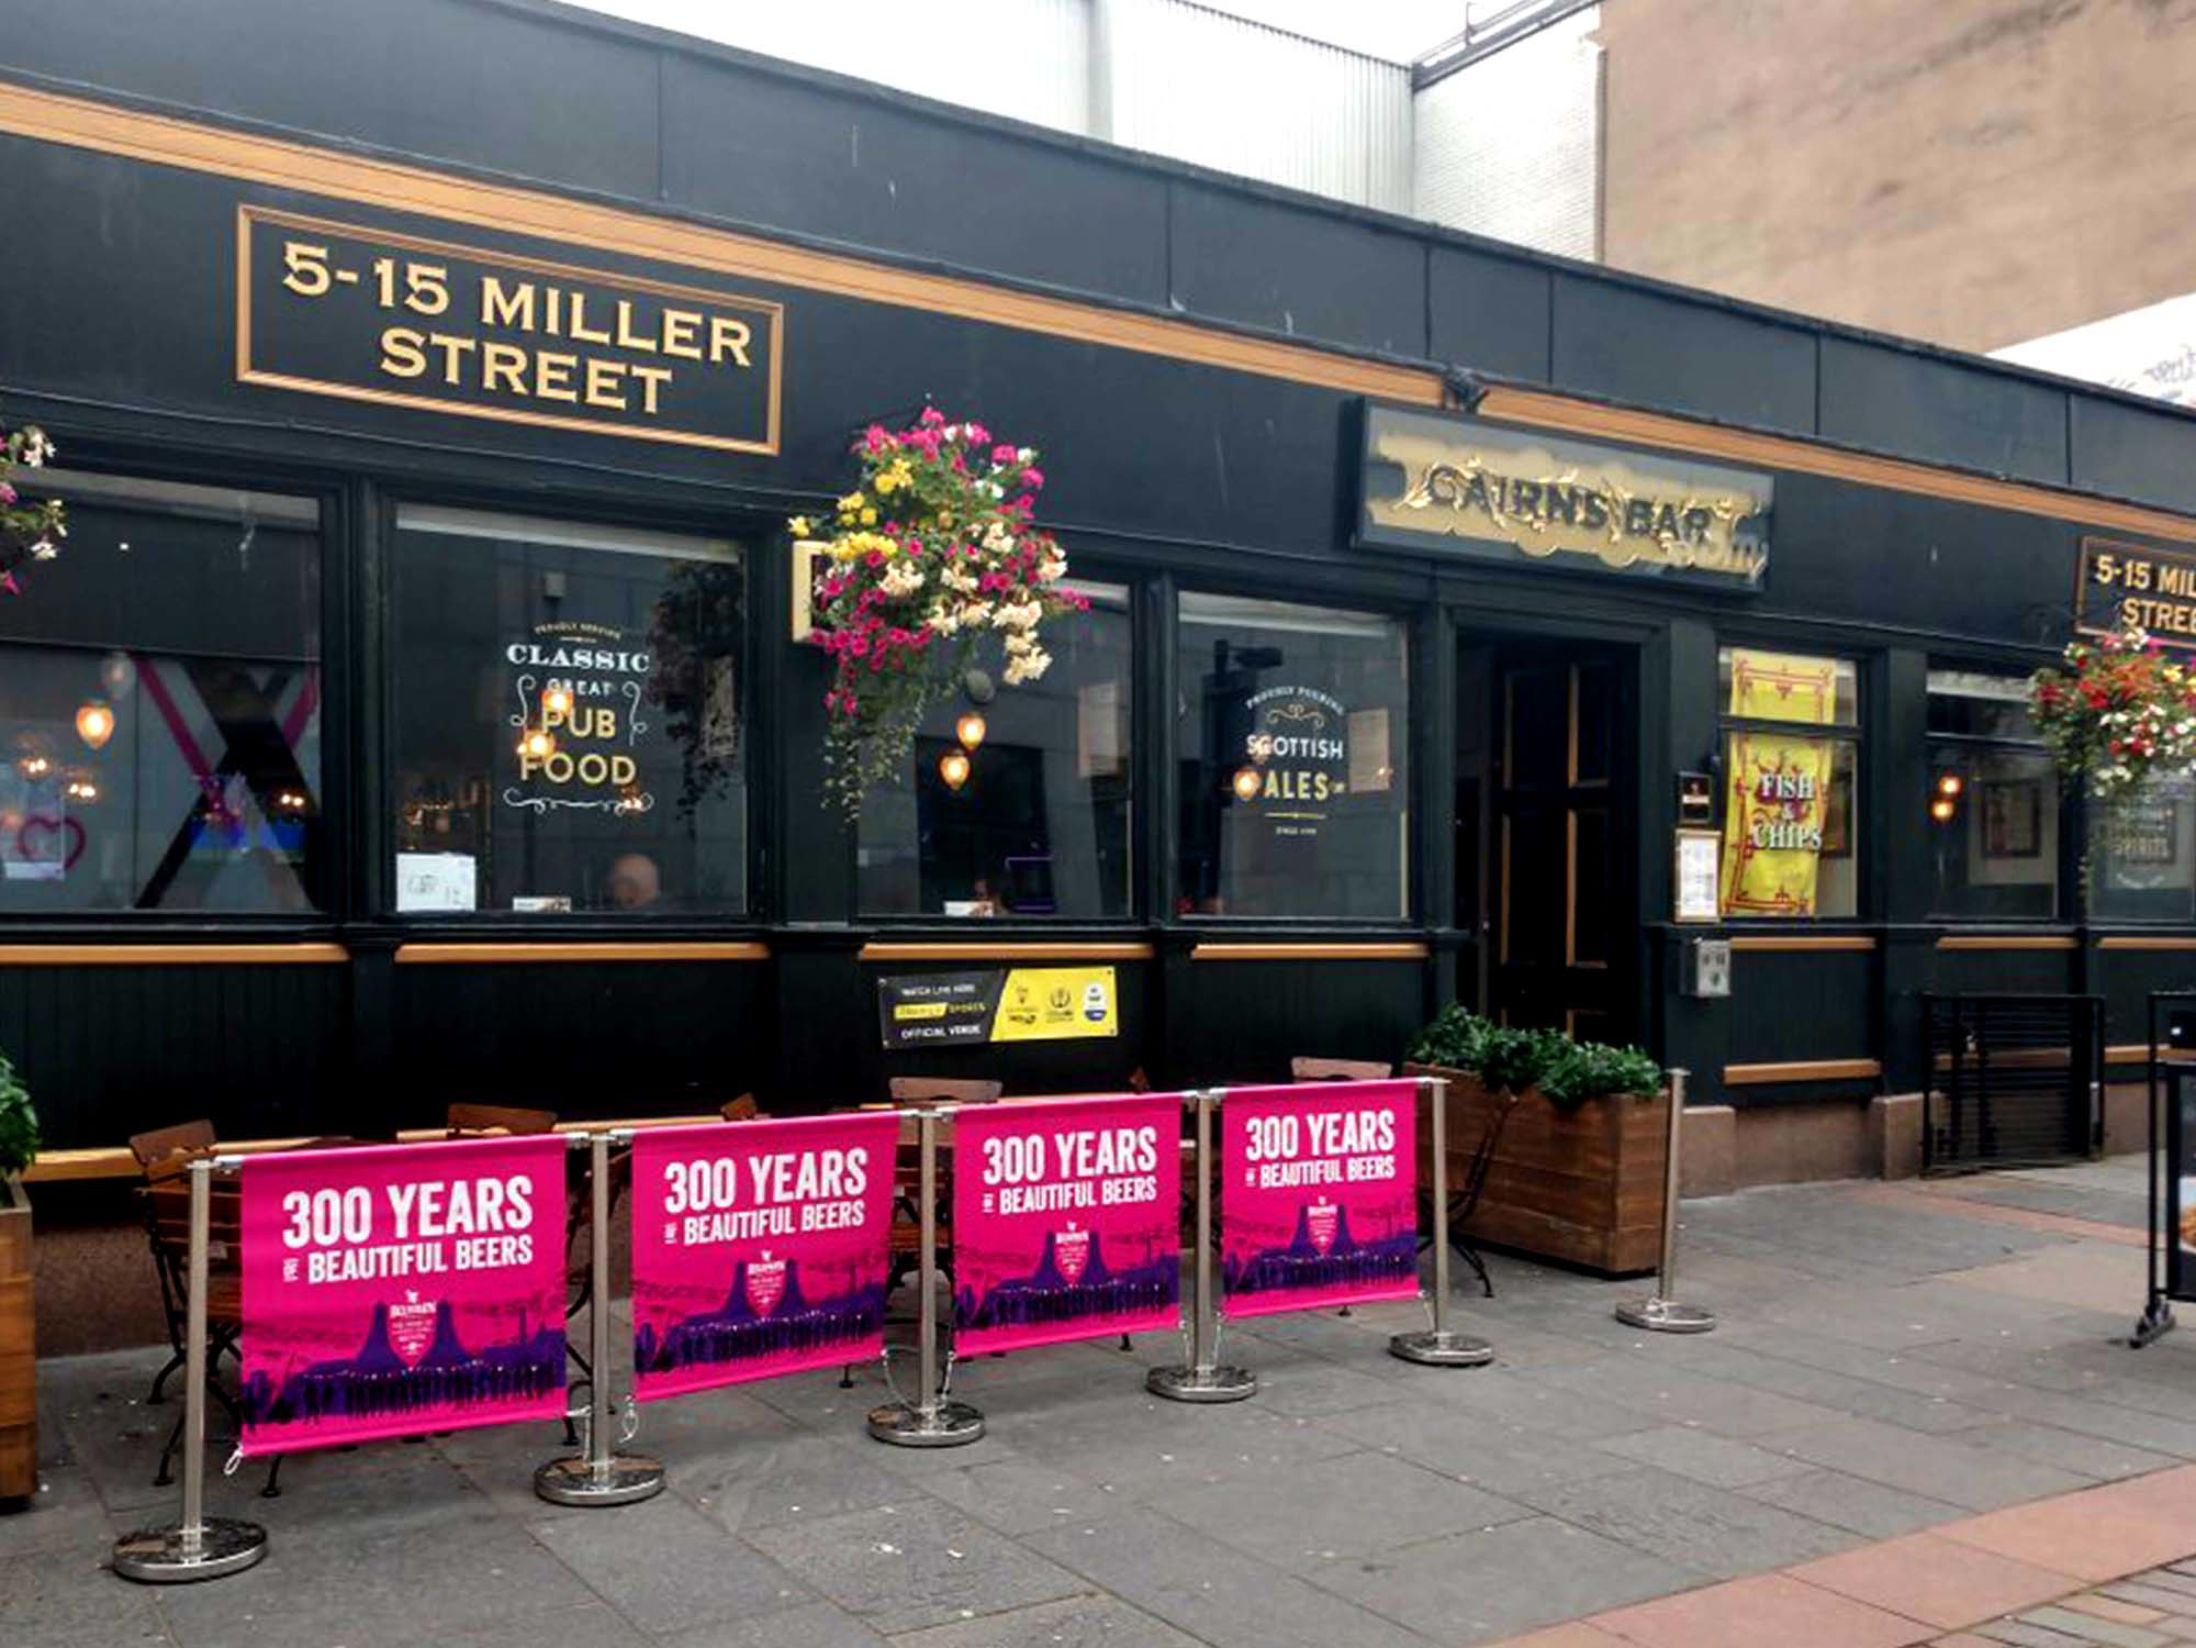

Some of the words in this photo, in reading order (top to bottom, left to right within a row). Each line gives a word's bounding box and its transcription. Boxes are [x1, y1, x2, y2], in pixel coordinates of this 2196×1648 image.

[282, 241, 450, 316] 5-15
[481, 276, 753, 367] MILLER
[380, 326, 673, 414] STREET
[1428, 464, 1609, 530] CAIRNS
[1625, 498, 1714, 543] BAR
[2095, 555, 2150, 590] 5-15
[506, 643, 650, 673] CLASSIC
[547, 677, 613, 697] GREAT
[541, 704, 616, 739] PUB
[1246, 733, 1344, 760] SCOTTISH
[520, 751, 637, 786] FOOD
[1263, 769, 1330, 801] ALES
[1760, 772, 1815, 800] FISH
[1751, 821, 1823, 850] CHIPS
[900, 1026, 946, 1040] OFFICIAL
[1245, 1115, 1299, 1161] 300
[1306, 1108, 1396, 1156] YEARS
[982, 1134, 1045, 1186] 300
[1054, 1126, 1158, 1179] YEARS
[1259, 1160, 1344, 1189] BEAUTIFUL
[1346, 1154, 1397, 1182] BEERS
[664, 1157, 737, 1214] 300
[748, 1147, 868, 1205] YEARS
[999, 1180, 1098, 1215] BEAUTIFUL
[1101, 1175, 1158, 1206] BEERS
[282, 1187, 373, 1249] 300
[386, 1174, 534, 1240] YEARS
[683, 1207, 796, 1247] BEAUTIFUL
[801, 1200, 866, 1232] BEERS
[307, 1241, 448, 1284] BEAUTIFUL
[455, 1234, 534, 1270] BEERS
